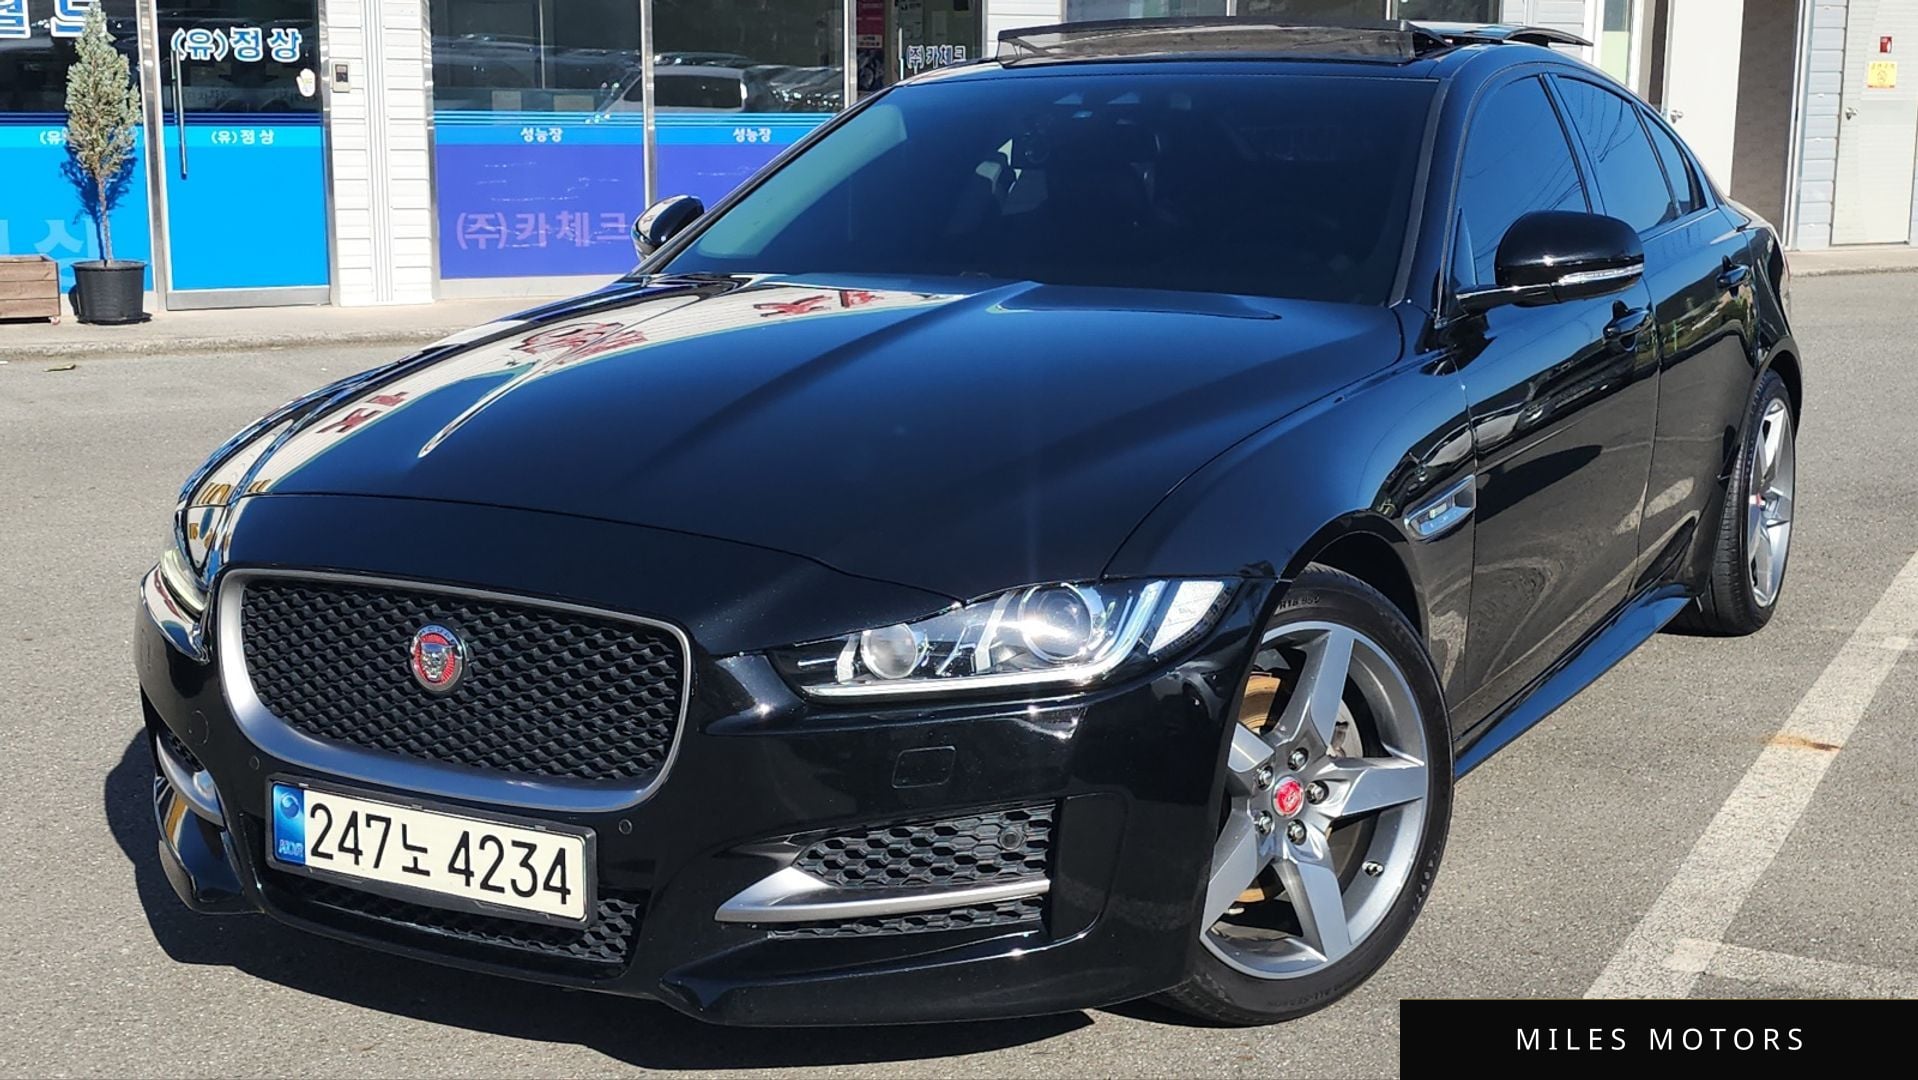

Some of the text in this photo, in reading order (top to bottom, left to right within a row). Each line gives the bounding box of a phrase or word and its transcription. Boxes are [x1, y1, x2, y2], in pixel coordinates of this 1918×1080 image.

[520, 128, 564, 143] 성능장
[732, 128, 772, 143] 성능장
[456, 211, 631, 249] (주)카체크
[448, 830, 572, 905] 4234
